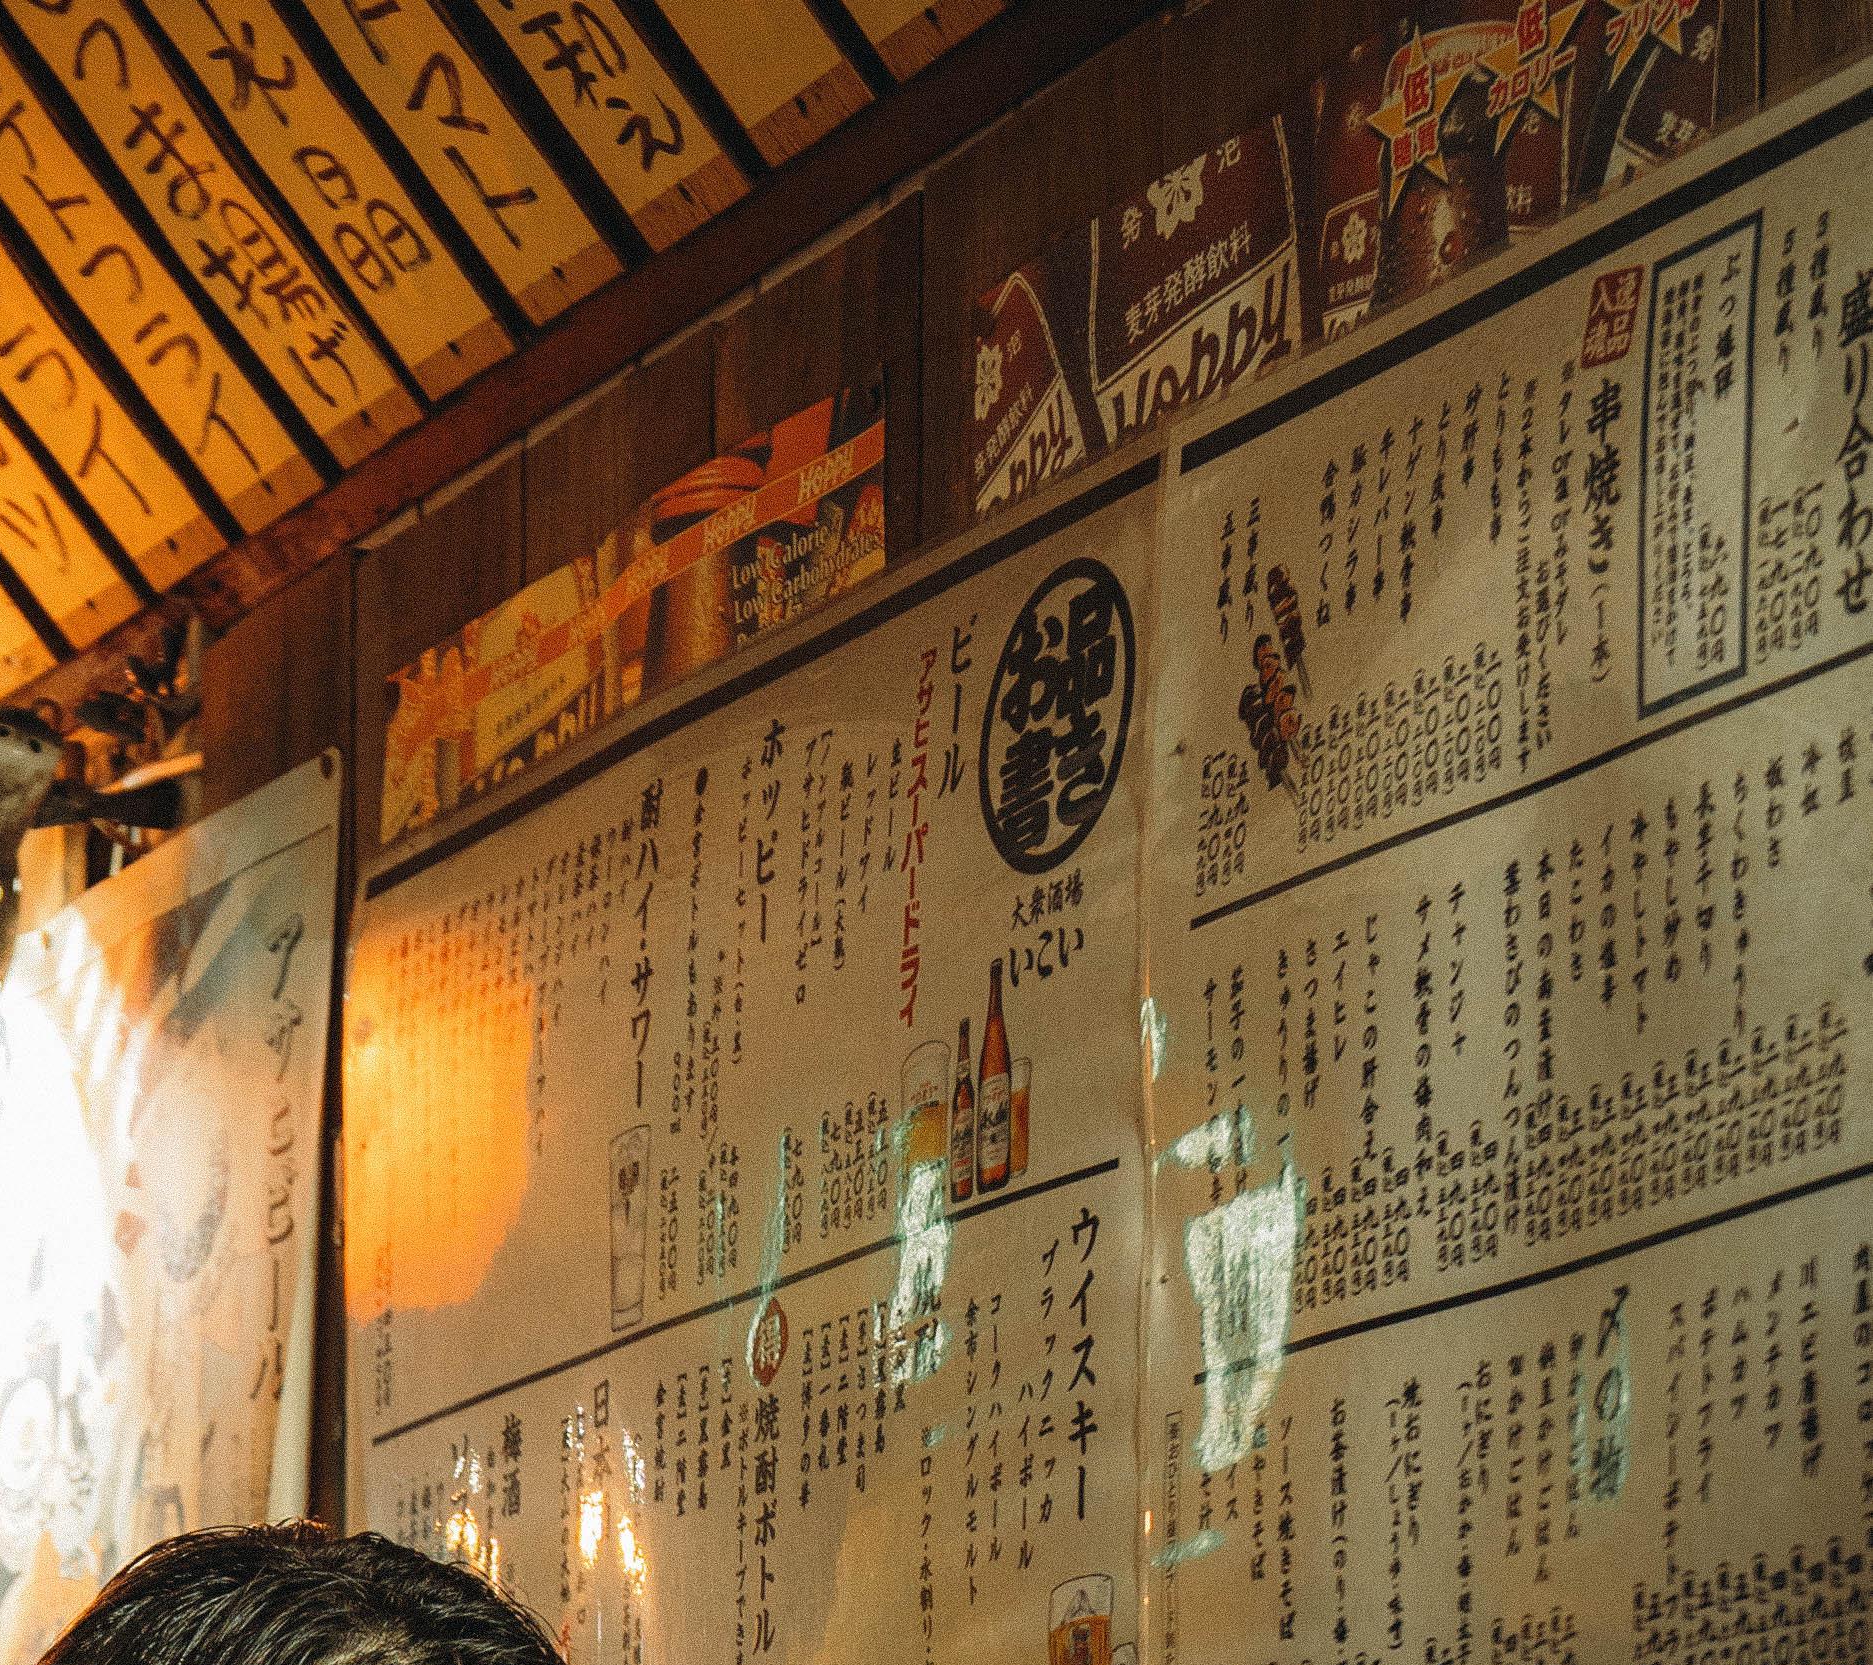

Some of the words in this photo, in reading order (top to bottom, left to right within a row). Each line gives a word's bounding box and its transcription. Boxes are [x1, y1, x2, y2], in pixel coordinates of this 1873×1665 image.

[1487, 46, 1577, 119] カロリー
[29, 0, 364, 408] つま揚げ
[1124, 218, 1252, 346] 麦芽発酵飲料
[937, 612, 979, 797] ビール
[754, 718, 786, 943] ホッピー
[898, 647, 937, 1026] アサヒスーパードライ
[1008, 926, 1085, 987] いこい
[1331, 929, 1350, 1063] エイヒレ
[500, 1413, 523, 1517] 梅酒
[987, 1292, 1004, 1562] コークハイボール
[1037, 1237, 1060, 1523] ブラックニッカ
[1067, 1207, 1100, 1519] ウイスキー
[752, 1394, 779, 1654] 焼酎ボトル
[1015, 1381, 1035, 1571] ハイボール
